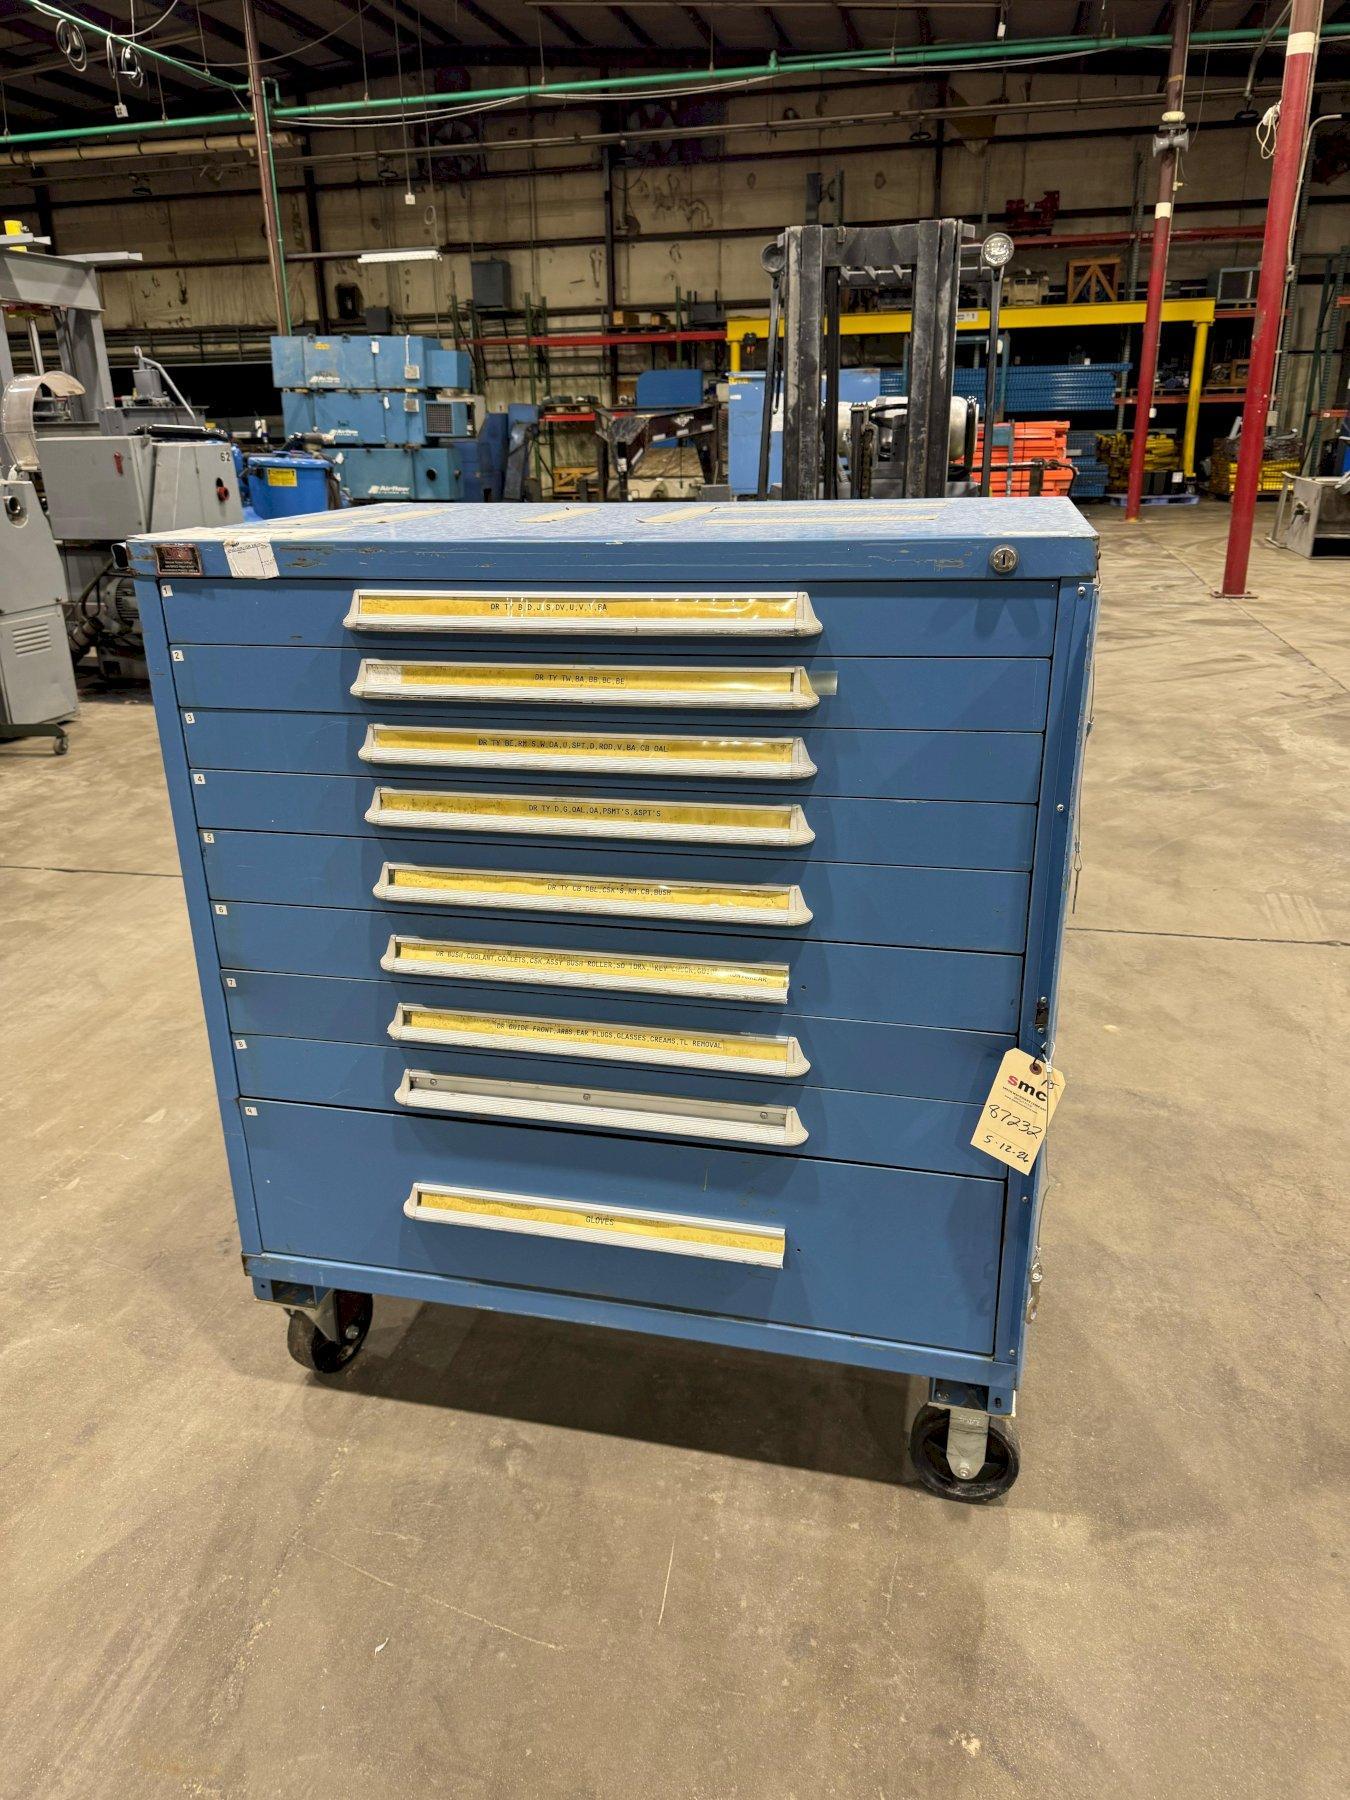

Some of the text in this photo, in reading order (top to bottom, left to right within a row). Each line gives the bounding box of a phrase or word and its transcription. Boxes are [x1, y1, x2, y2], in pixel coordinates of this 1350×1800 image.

[174, 651, 181, 660] 2
[187, 714, 193, 722] 3
[197, 775, 203, 783] 4
[218, 905, 224, 913] 6
[508, 1023, 529, 1031] GUIDE
[692, 1040, 722, 1049] REMOVAL
[988, 1104, 1043, 1140] 87232
[585, 1215, 616, 1226] GLOVES
